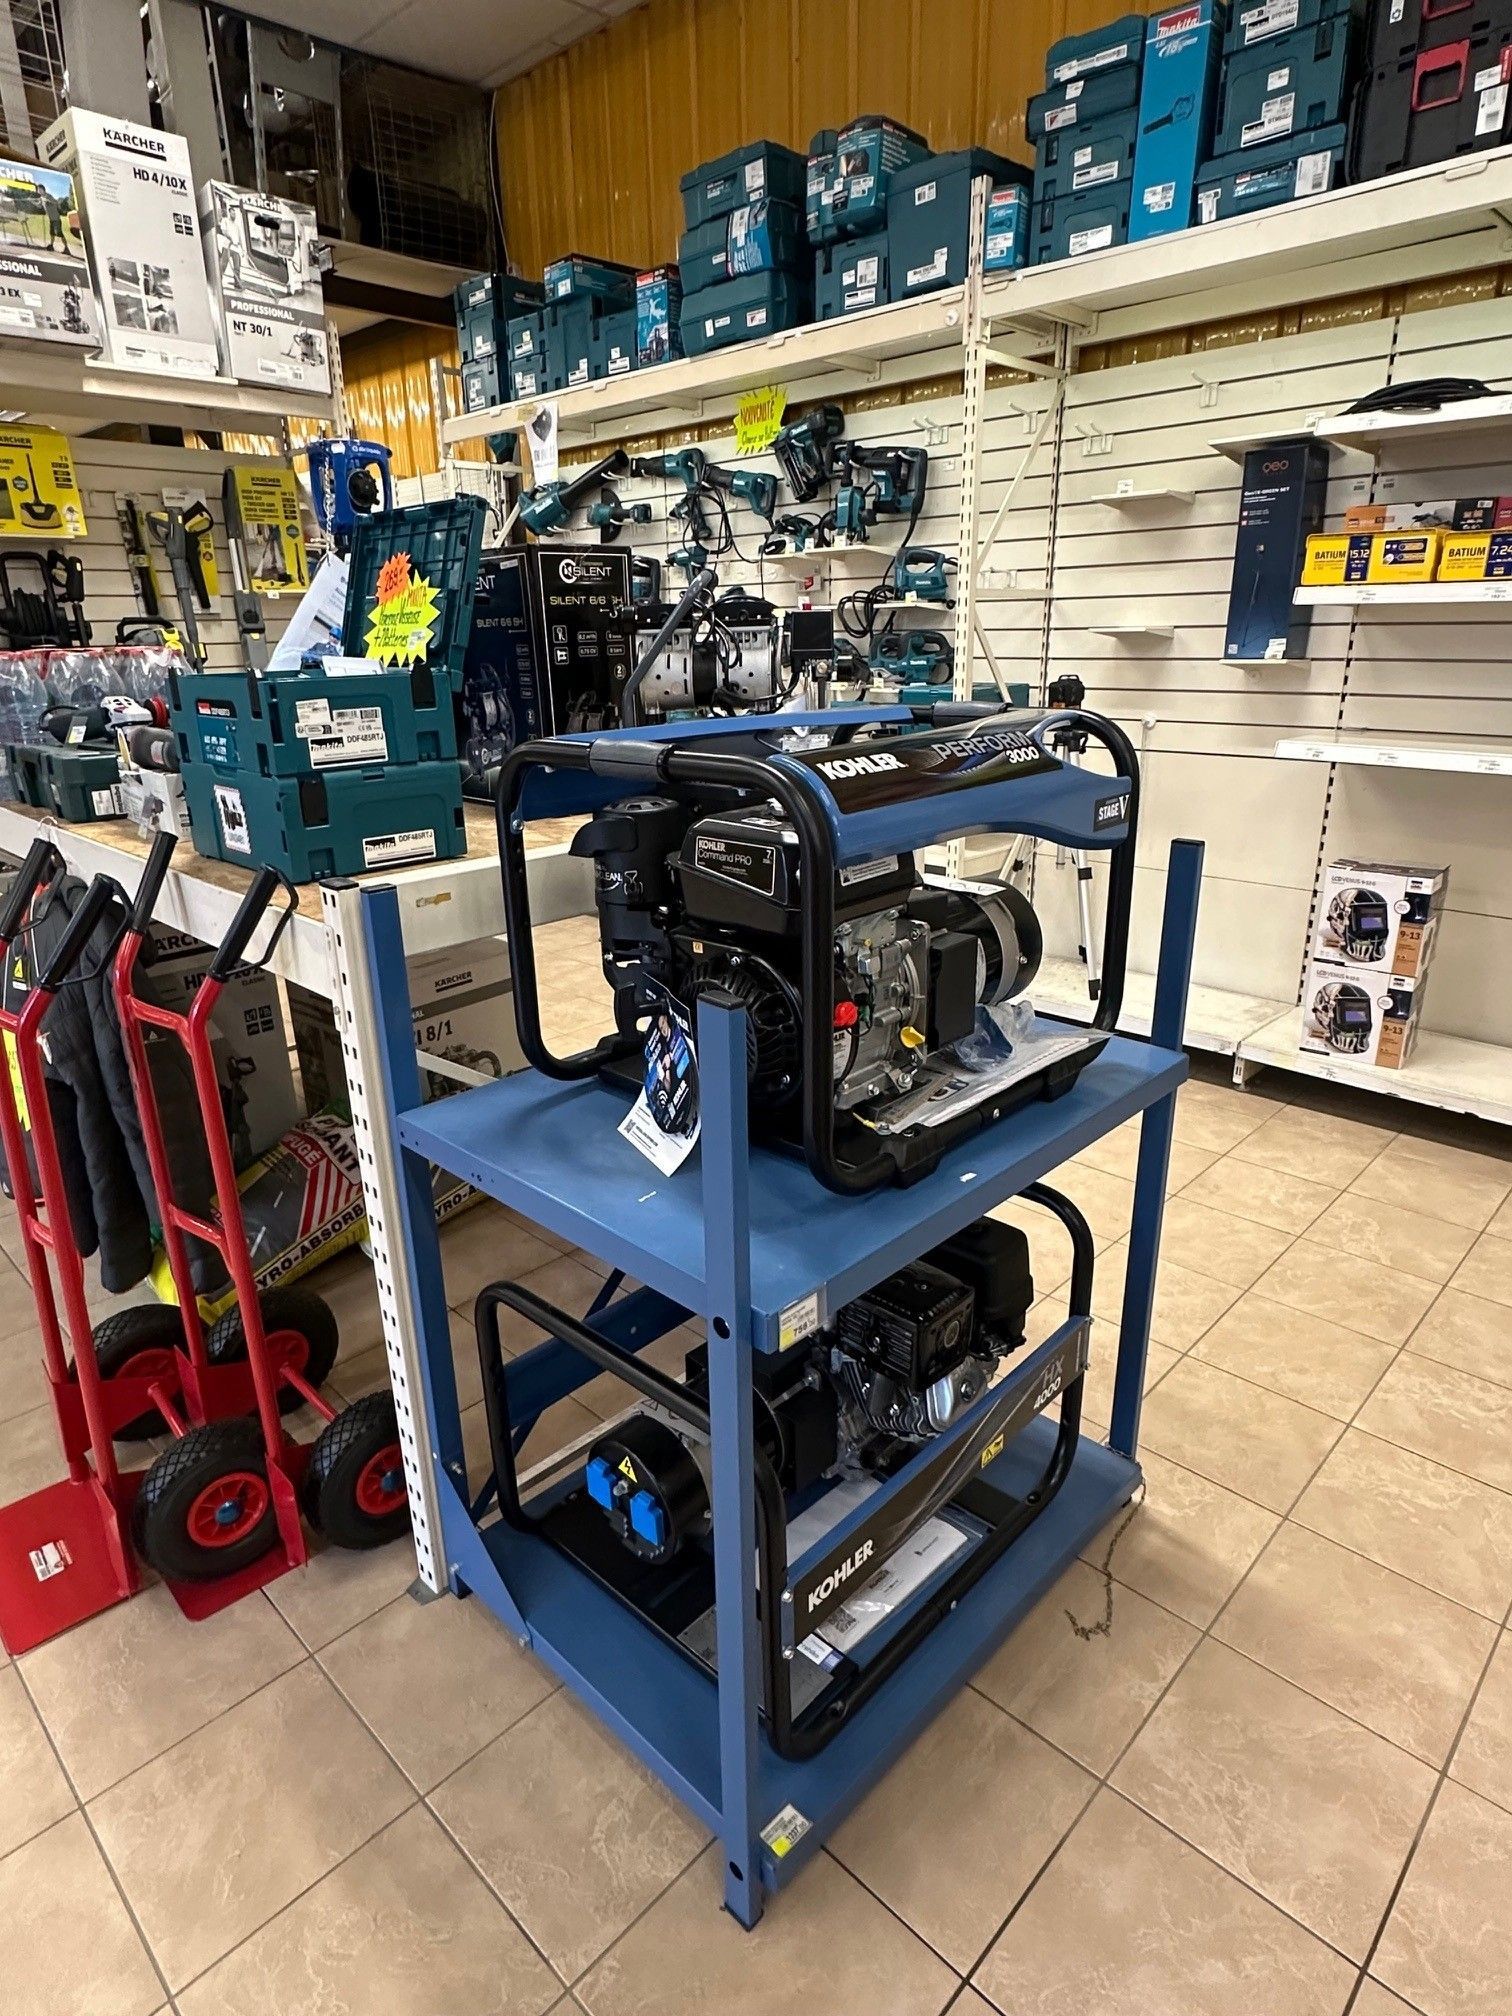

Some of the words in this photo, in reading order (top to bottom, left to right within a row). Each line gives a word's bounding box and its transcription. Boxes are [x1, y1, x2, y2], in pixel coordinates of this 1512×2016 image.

[133, 167, 149, 181] HD
[8, 288, 21, 298] EX
[230, 299, 295, 321] PROFESSIONAL
[233, 320, 247, 333] NT
[250, 323, 273, 337] 30/1
[1315, 550, 1346, 560] BATIUM
[1448, 546, 1486, 558] BATIUM
[572, 566, 613, 578] SILENT
[549, 596, 586, 606] SILENT
[589, 596, 606, 605] 6/6
[476, 617, 499, 628] SILENT
[931, 730, 1033, 761] PERFORM
[1005, 746, 1040, 764] 3000
[815, 752, 909, 781] KOHLER
[1098, 802, 1120, 821] STAGE
[1118, 794, 1130, 820] V
[698, 838, 726, 852] KOHLER
[698, 849, 734, 863] Command
[734, 854, 752, 866] PRO
[766, 849, 771, 859] 7
[1400, 930, 1421, 941] 9-13
[426, 1019, 453, 1041] 8/1
[1383, 1025, 1403, 1035] 9-13
[808, 1539, 875, 1613] KOHLER
